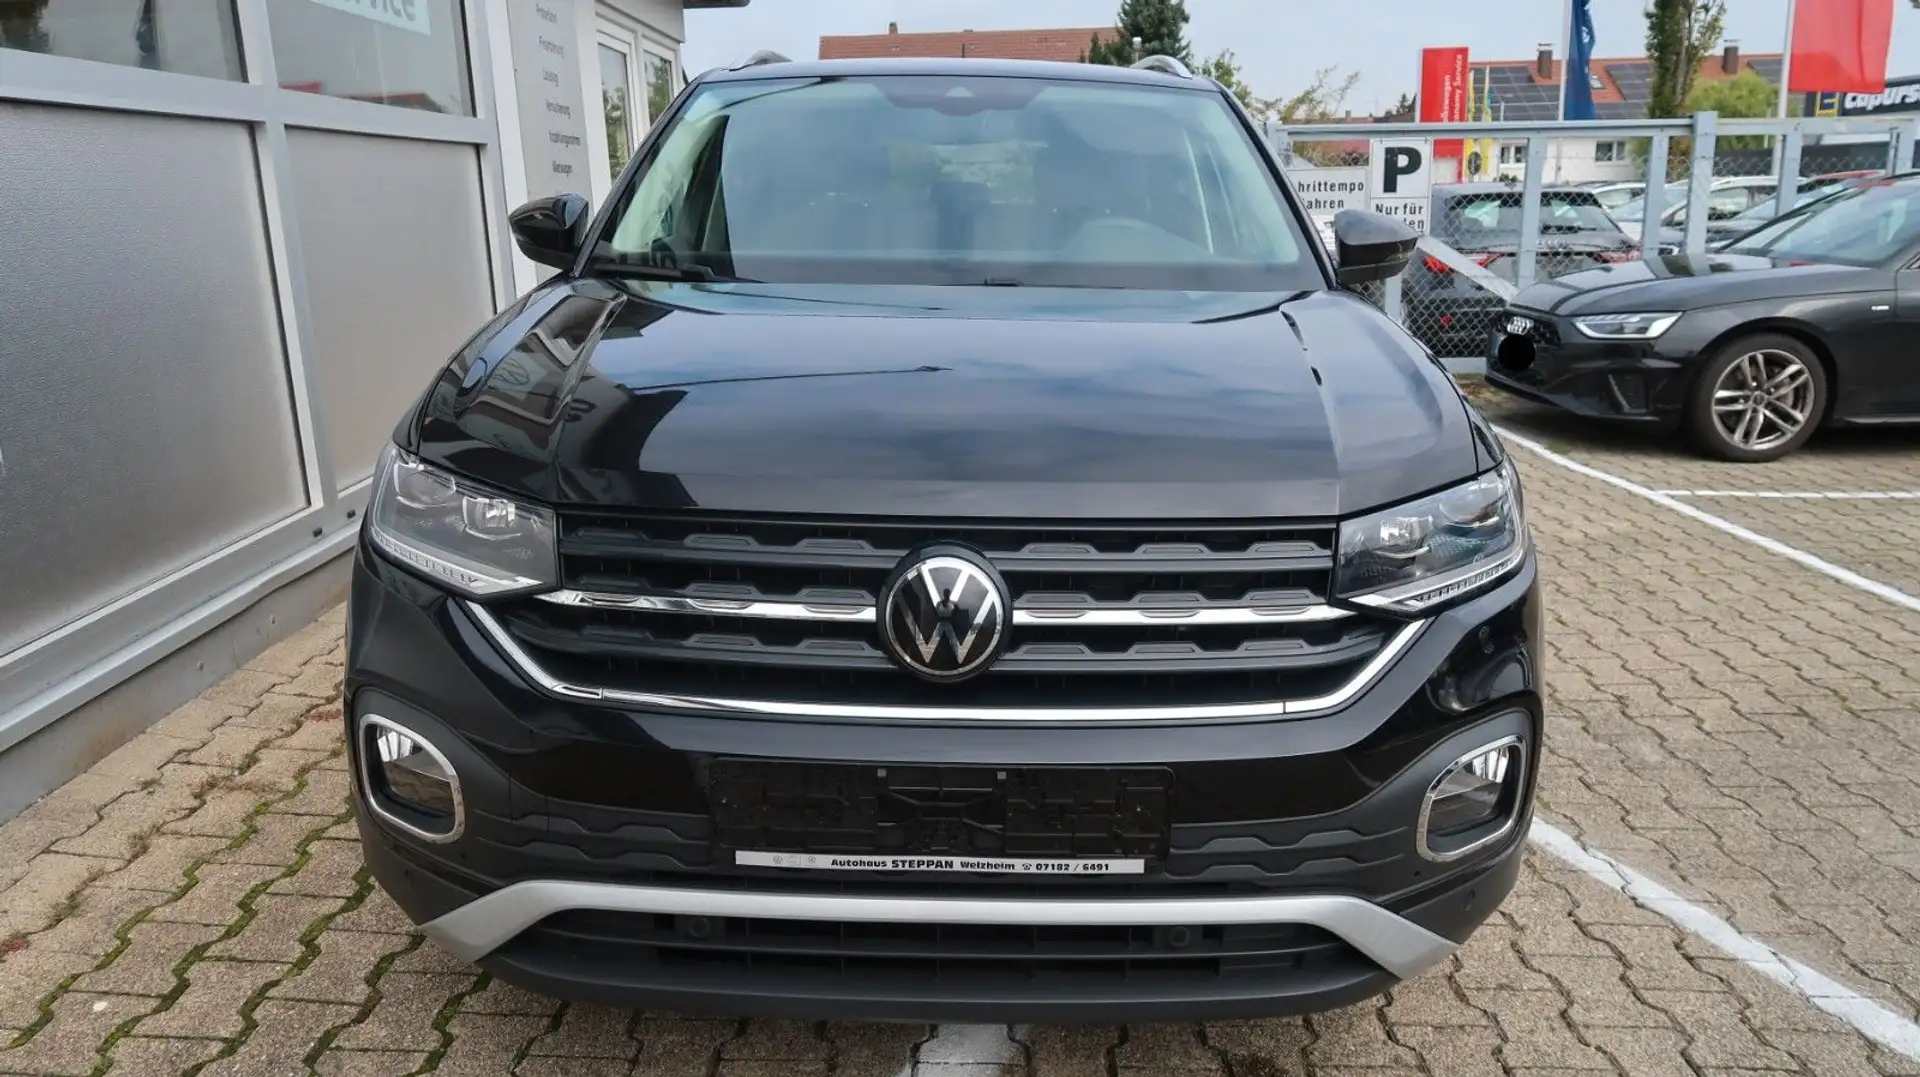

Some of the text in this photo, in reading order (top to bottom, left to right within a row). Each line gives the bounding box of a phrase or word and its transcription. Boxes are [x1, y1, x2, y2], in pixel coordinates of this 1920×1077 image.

[1844, 83, 1920, 110] capurs
[1383, 146, 1422, 193] P
[1298, 180, 1365, 194] hrittempo
[1303, 197, 1344, 210] ahren
[1375, 202, 1424, 215] Nur für
[831, 858, 887, 868] Autohaus
[891, 859, 953, 870] STEPPAN
[960, 860, 1015, 871] Welzheim
[1035, 862, 1070, 872] 07182
[1082, 862, 1110, 872] 6491
